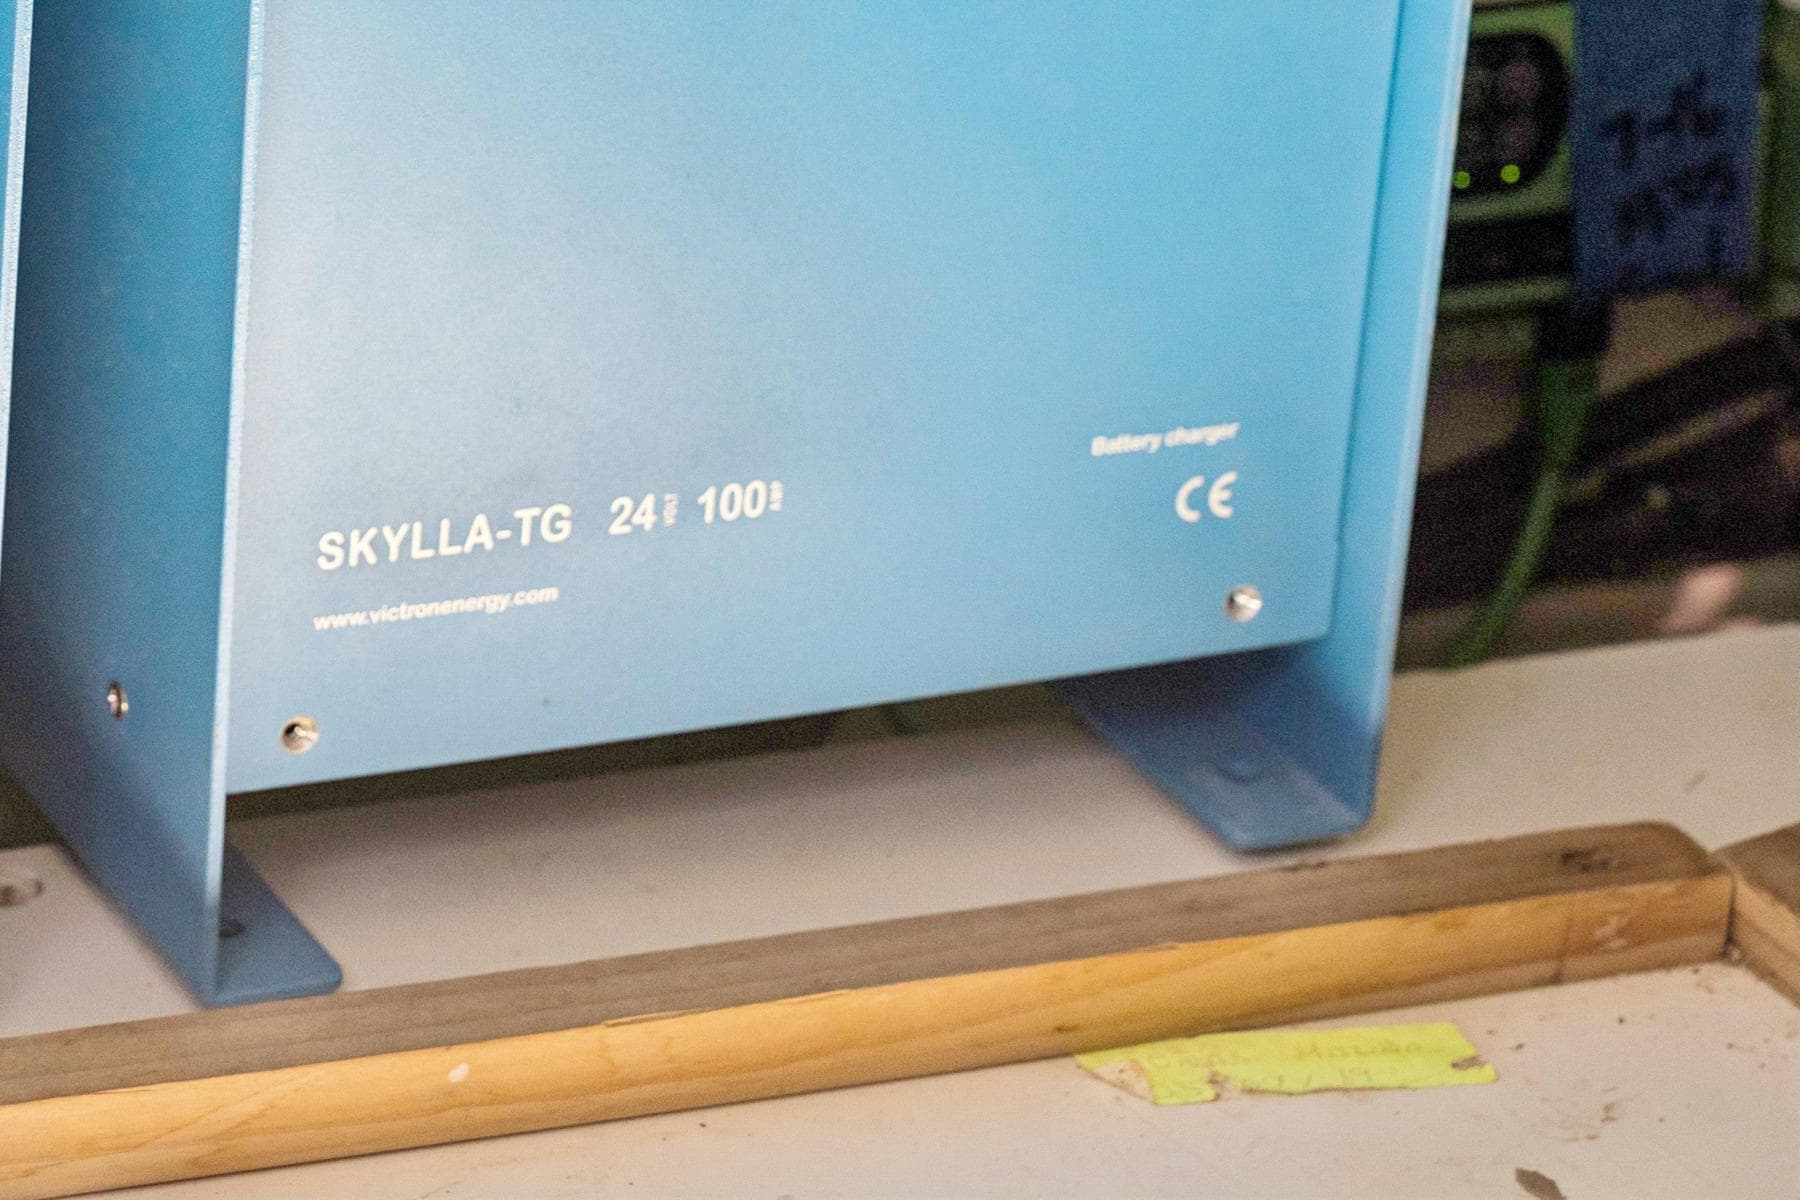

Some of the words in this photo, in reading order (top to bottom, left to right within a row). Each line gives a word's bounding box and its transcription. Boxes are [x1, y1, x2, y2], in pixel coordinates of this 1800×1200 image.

[1175, 471, 1237, 523] CE
[316, 503, 572, 571] SKYLLA-TG
[608, 492, 658, 536] 24
[697, 479, 768, 524] 100
[312, 586, 559, 631] www.victronenergy.com
